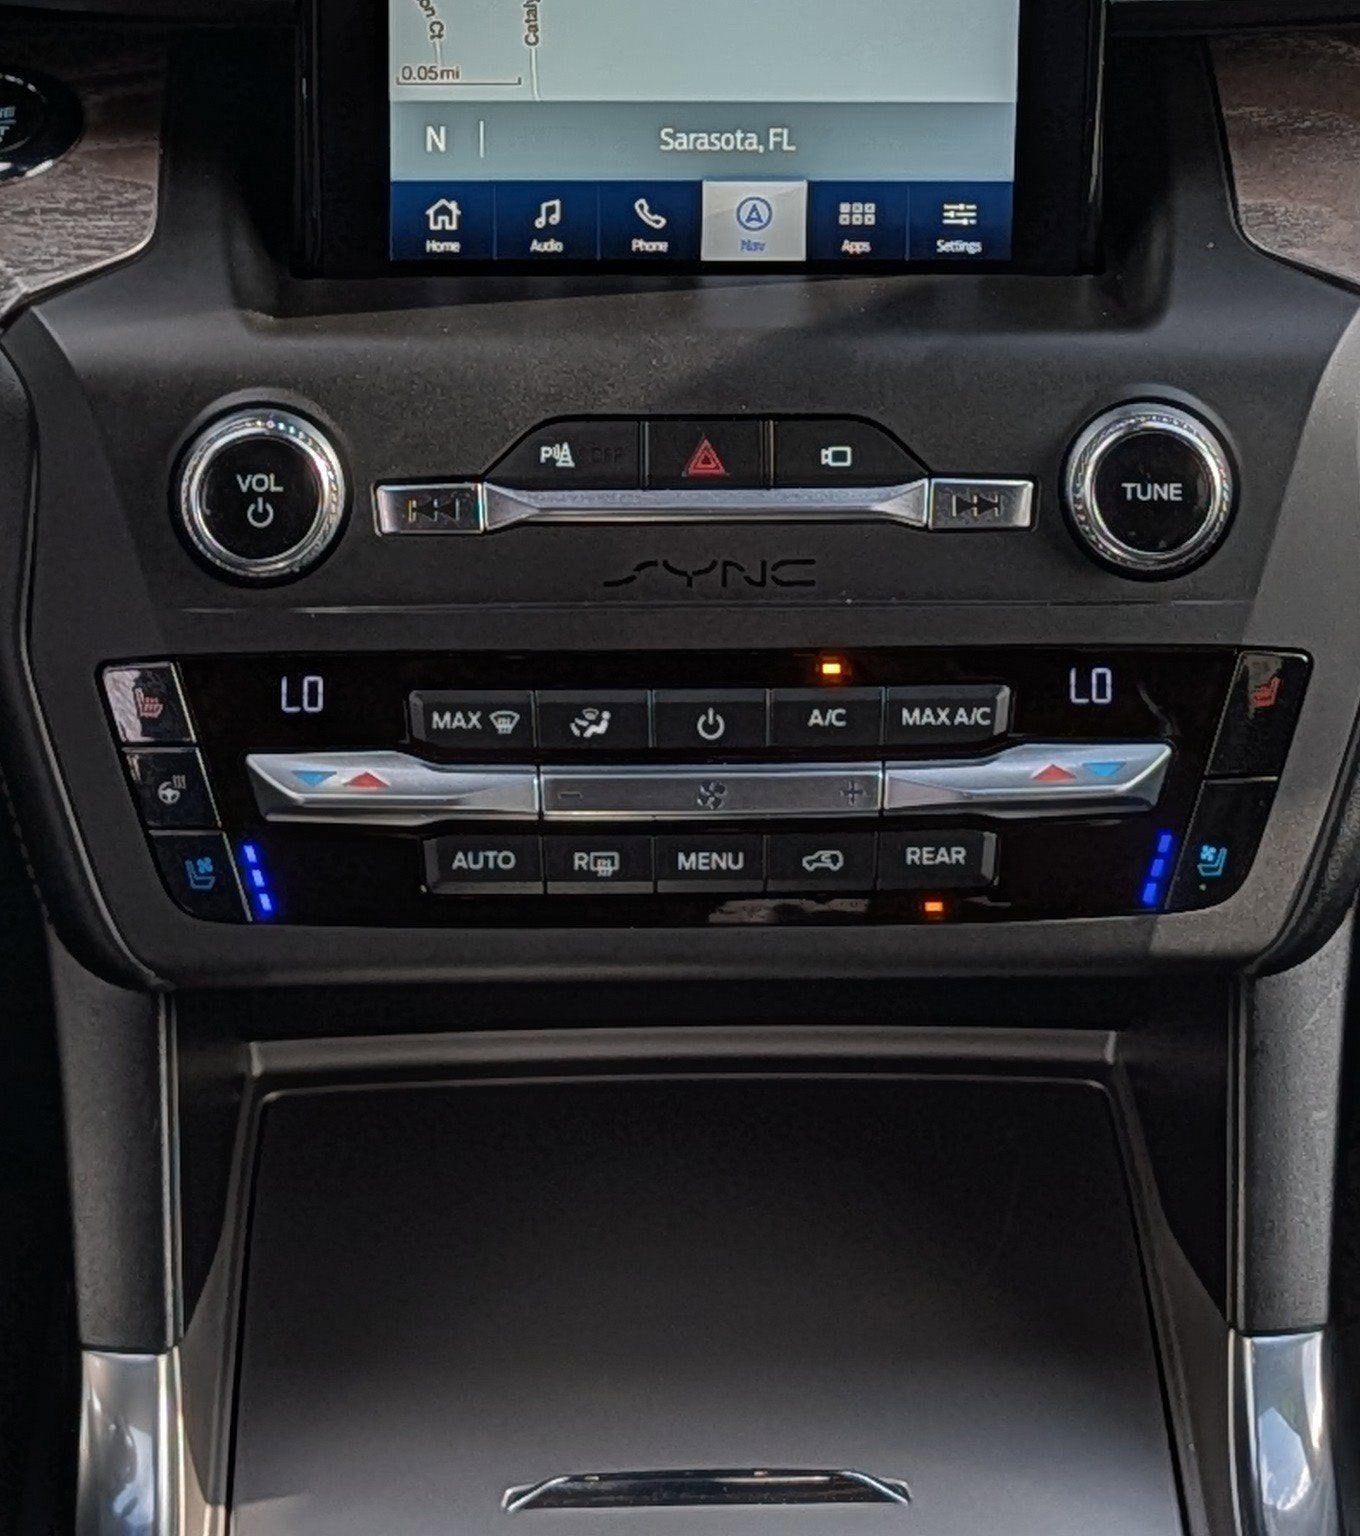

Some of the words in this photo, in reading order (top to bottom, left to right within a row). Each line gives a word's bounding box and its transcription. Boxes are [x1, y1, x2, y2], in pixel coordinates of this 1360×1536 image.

[428, 20, 444, 40] Ct
[425, 125, 447, 153] N
[659, 127, 764, 154] Sarasota,
[768, 127, 796, 151] FL
[425, 238, 461, 253] Home
[529, 238, 564, 253] Audio
[631, 238, 669, 253] Phone
[741, 239, 766, 252] Nav
[841, 238, 871, 255] Apps
[936, 238, 982, 255] Settings
[236, 473, 284, 494] VOL
[1121, 481, 1183, 502] TUNE
[603, 559, 816, 588] SYNC
[280, 675, 324, 713] LO
[1069, 667, 1111, 704] LO
[431, 710, 482, 731] MAX
[808, 707, 847, 729] A/C
[902, 707, 952, 727] MAX
[953, 707, 992, 728] A/C
[452, 850, 516, 871] AUTO
[678, 850, 745, 872] MENU
[906, 845, 967, 866] REAR
